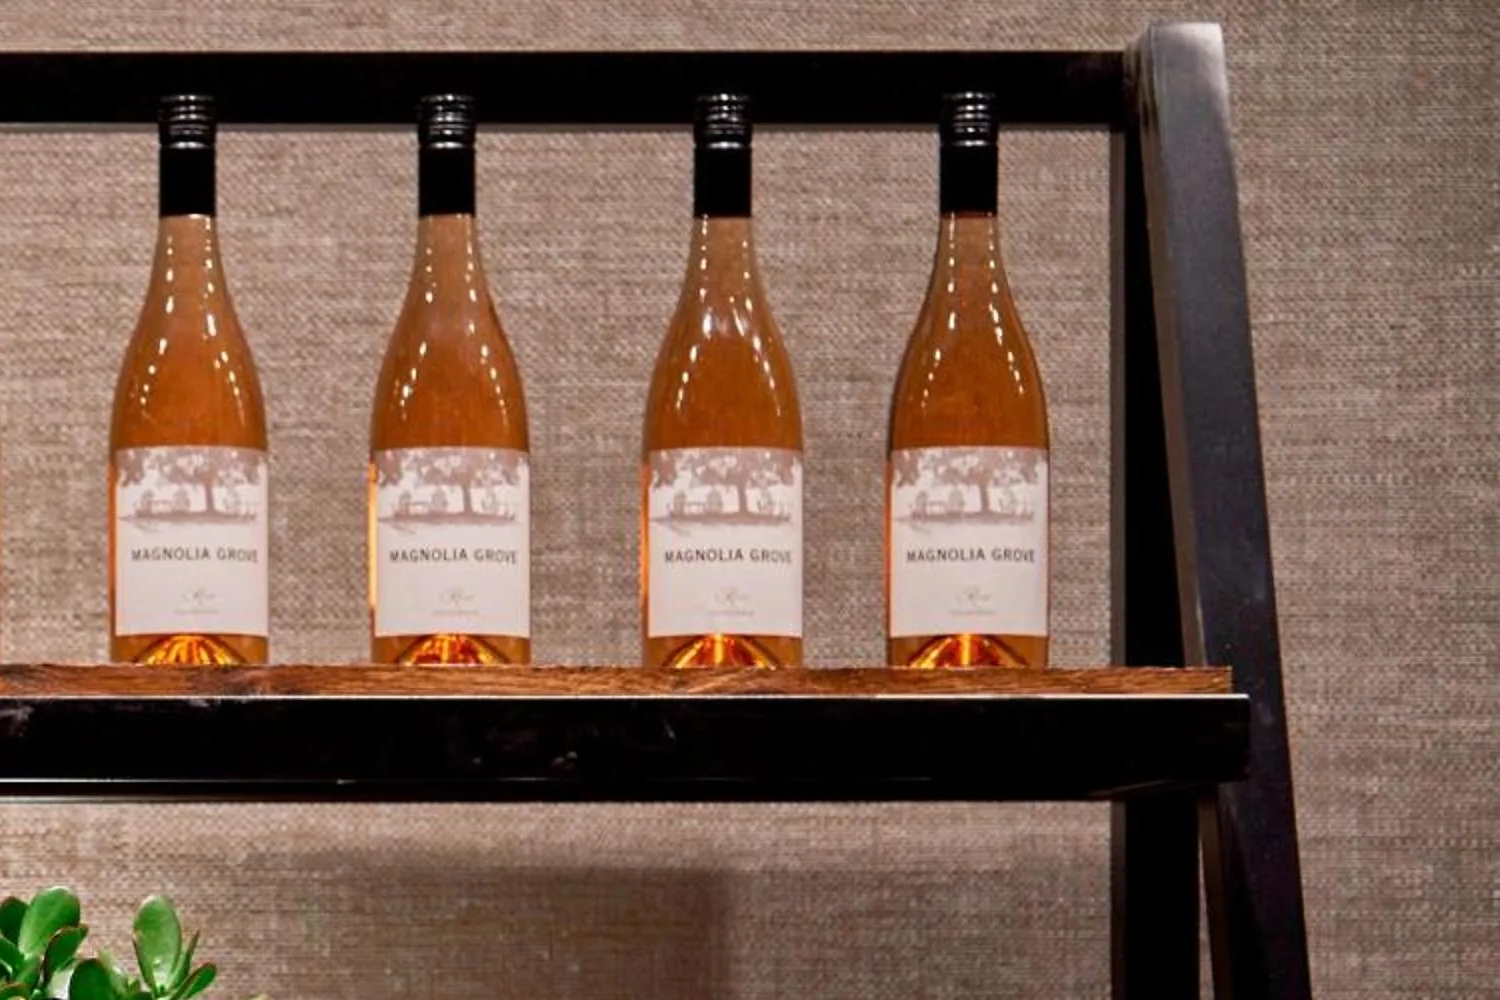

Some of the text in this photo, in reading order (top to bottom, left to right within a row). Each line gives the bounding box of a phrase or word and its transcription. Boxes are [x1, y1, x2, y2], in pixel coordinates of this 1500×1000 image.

[130, 546, 259, 564] MAGNOLIA GROVE
[388, 547, 518, 565] MAGNOLIA GROVE
[663, 547, 792, 565] MAGNOLIA GROVE
[906, 547, 1036, 564] MAGNOLIA GROVE
